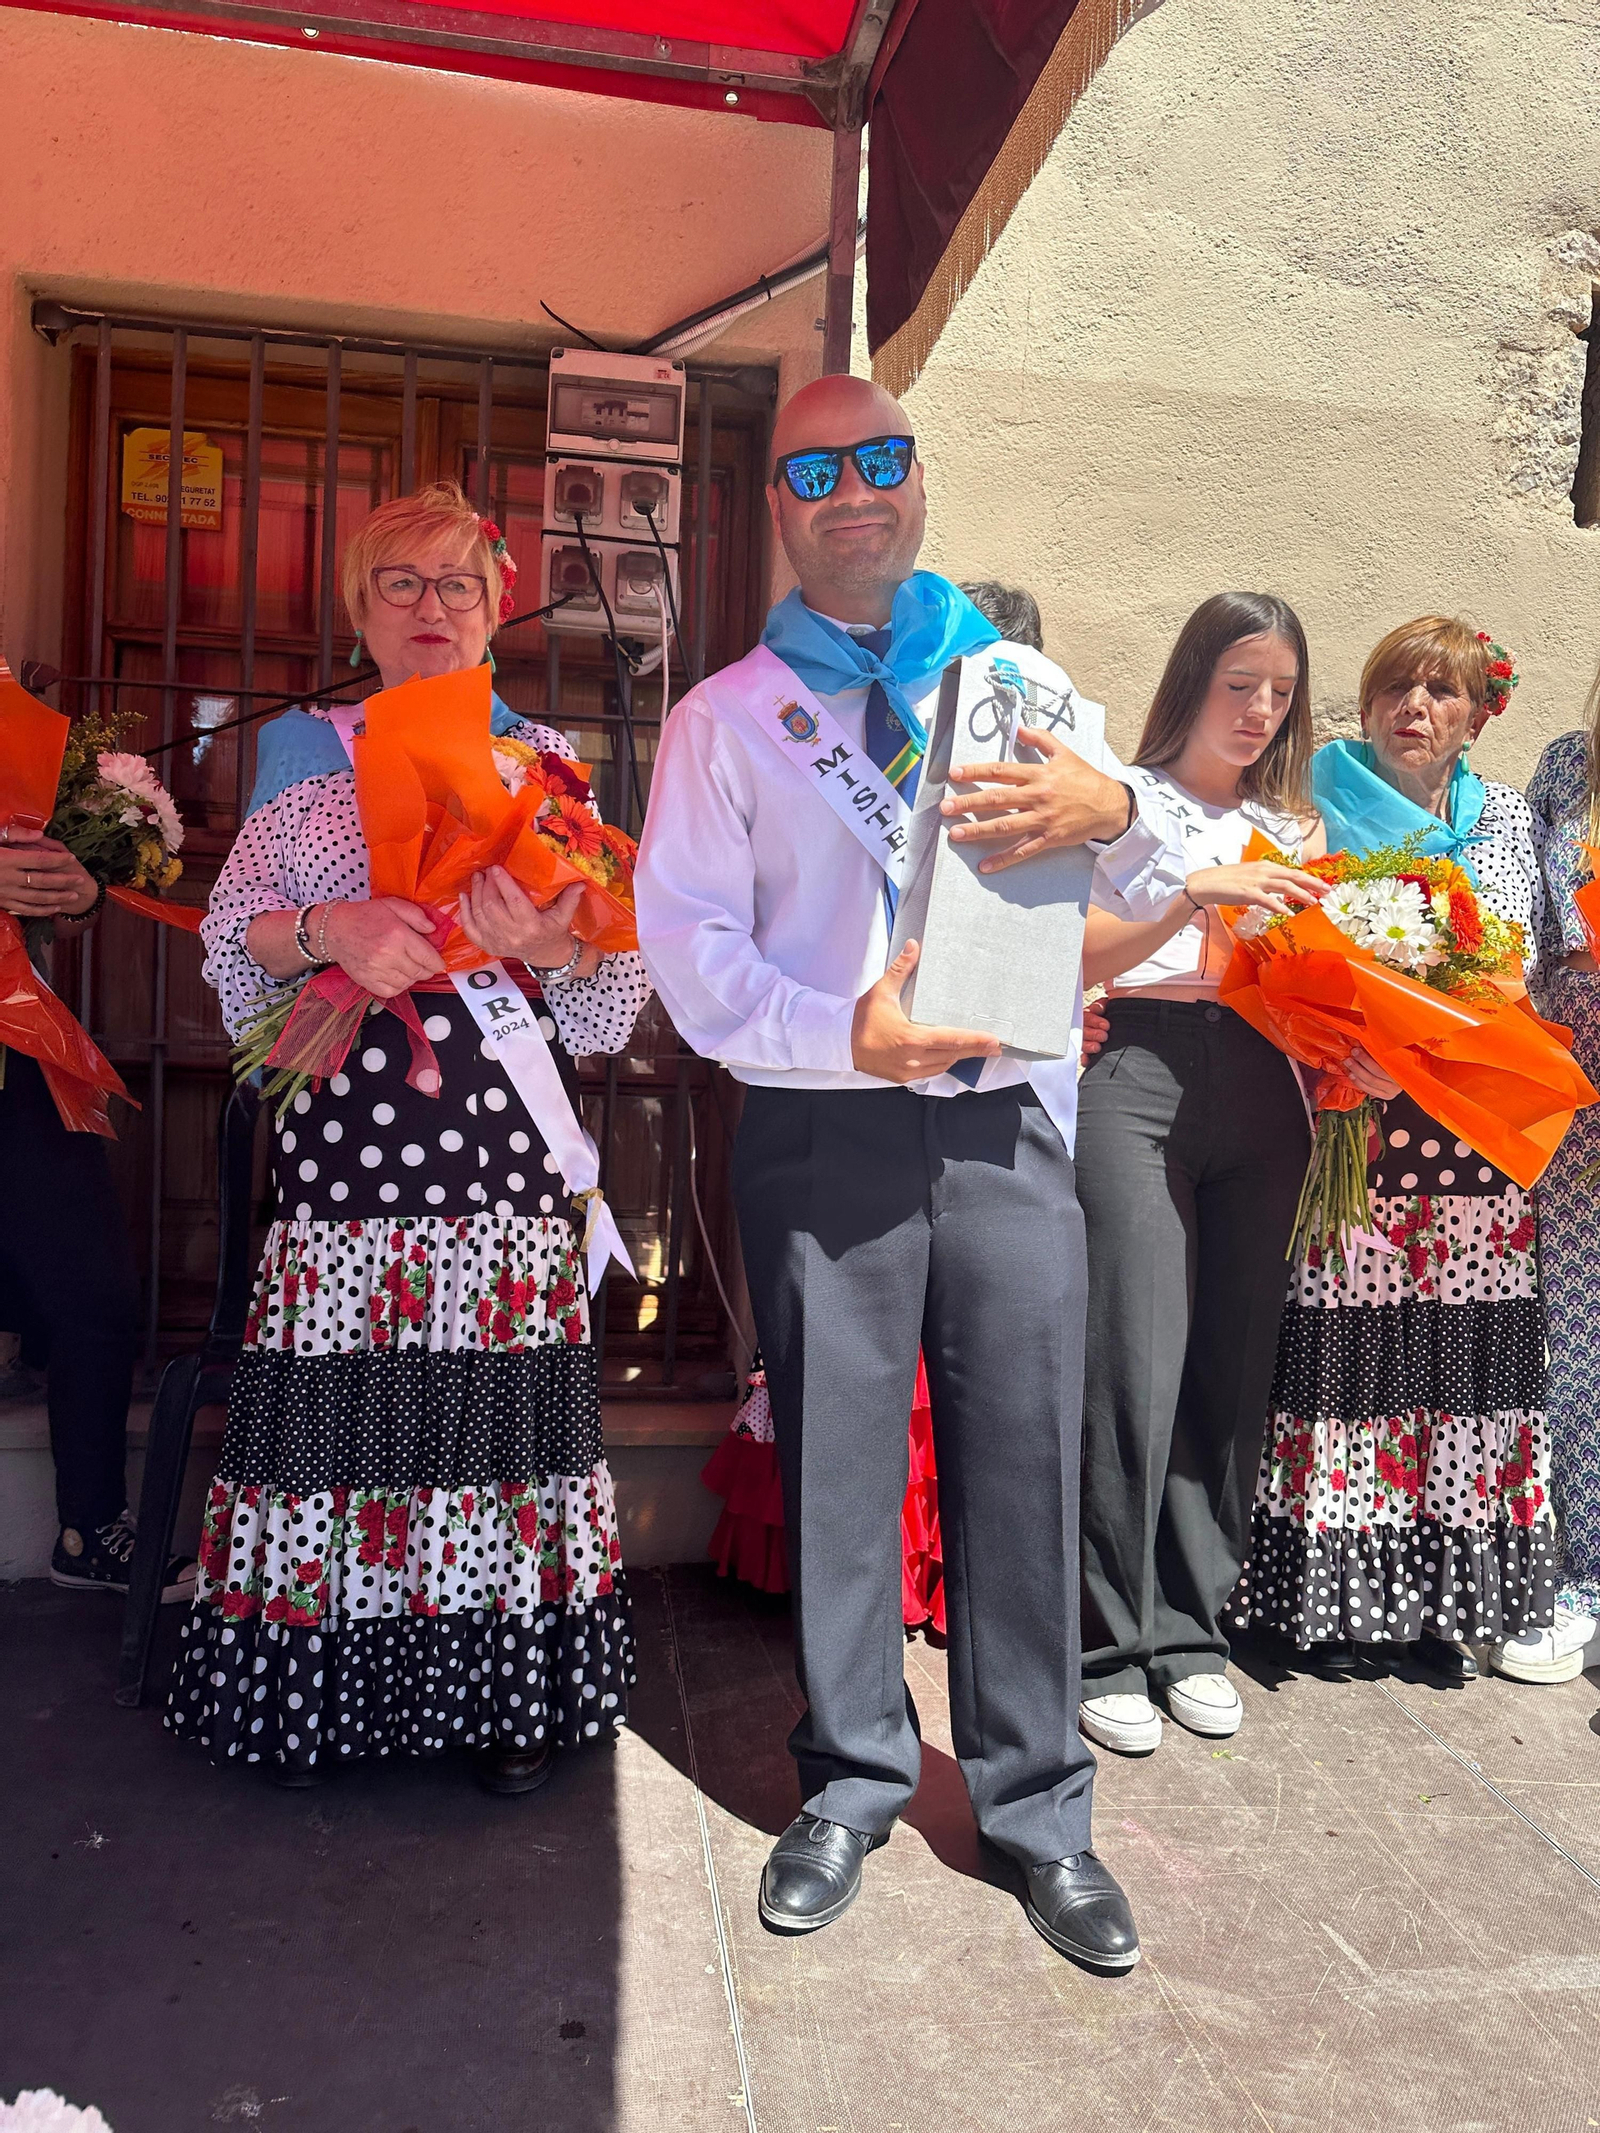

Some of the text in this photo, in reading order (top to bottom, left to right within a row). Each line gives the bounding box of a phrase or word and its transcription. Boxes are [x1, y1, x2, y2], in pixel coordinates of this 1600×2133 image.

[148, 454, 198, 463] SECEC
[181, 485, 216, 495] EGURETAT
[131, 491, 153, 502] TEL.
[155, 494, 170, 503] 90
[190, 497, 202, 506] 77
[203, 498, 216, 508] 52
[126, 507, 217, 526] CONNTADA
[810, 742, 908, 863] MISTE
[492, 1017, 530, 1042] 2024
